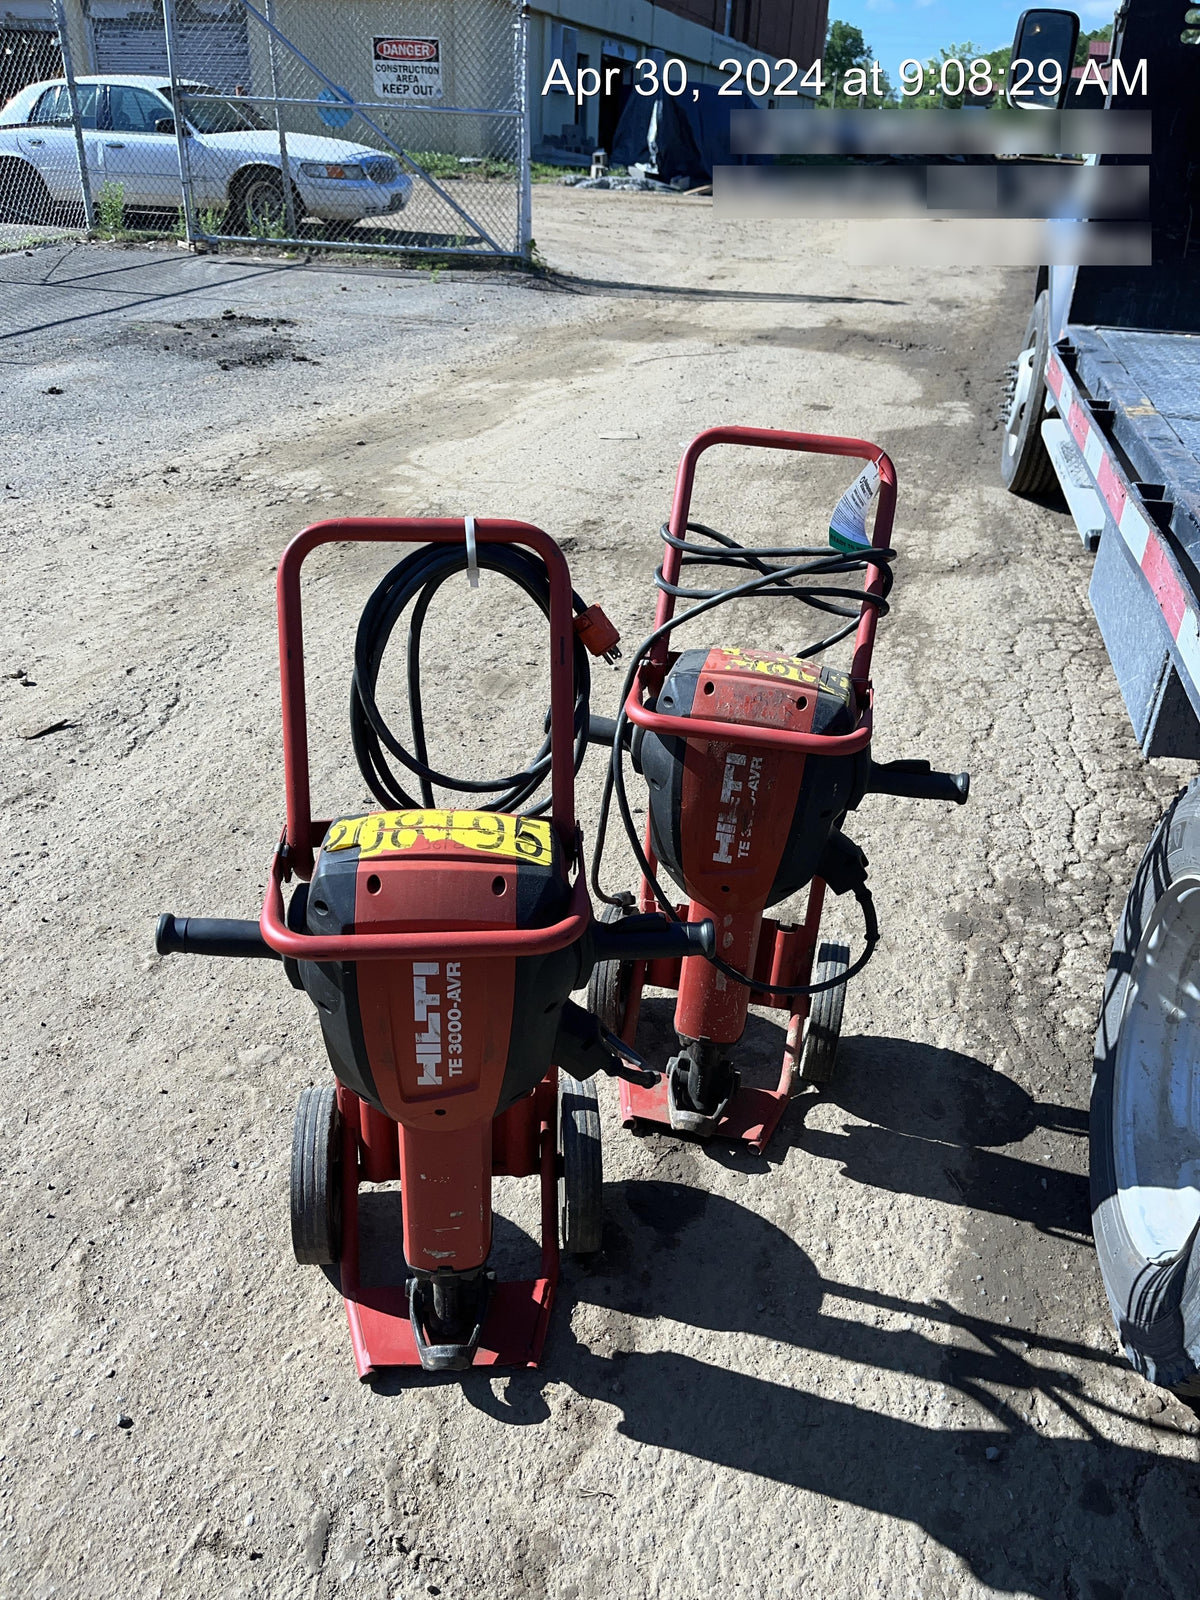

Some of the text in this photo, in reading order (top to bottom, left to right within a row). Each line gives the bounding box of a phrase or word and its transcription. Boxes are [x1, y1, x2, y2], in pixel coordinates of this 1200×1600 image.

[383, 44, 430, 56] DANGER
[375, 64, 439, 75] CONSTRUCTION
[396, 75, 419, 83] AREA
[382, 83, 434, 96] KEEP OUT
[737, 841, 751, 858] TE
[412, 962, 442, 1085] HILTI
[446, 962, 463, 1077] TE 3000-AVR
